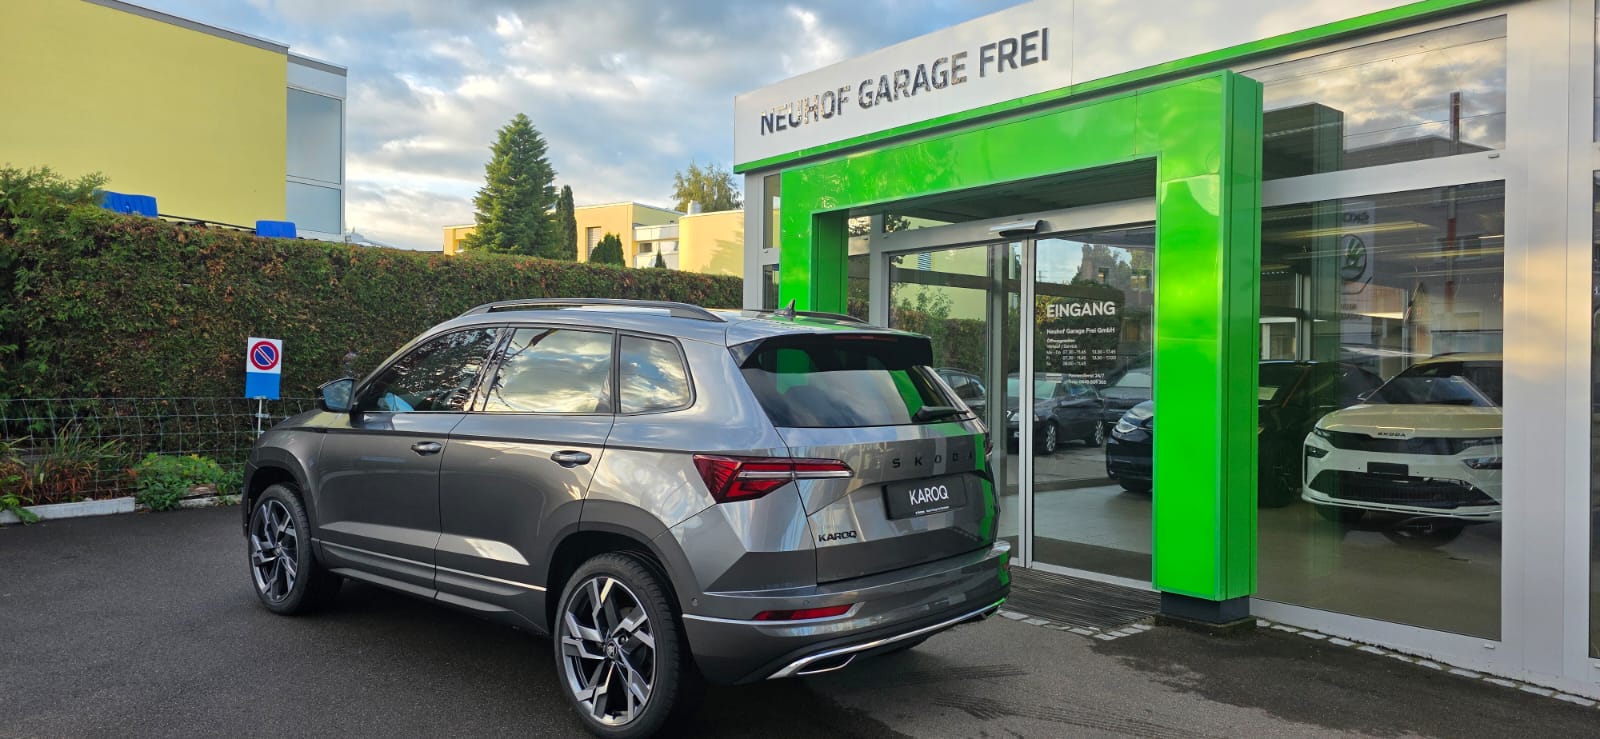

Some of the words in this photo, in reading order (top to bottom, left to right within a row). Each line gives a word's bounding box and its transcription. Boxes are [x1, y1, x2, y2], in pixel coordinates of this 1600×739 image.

[760, 85, 851, 136] NEUHOF
[858, 51, 968, 109] GARAGE
[979, 28, 1049, 77] FREI
[1046, 301, 1116, 318] EINGANG
[1066, 327, 1085, 336] Garage
[1086, 327, 1097, 335] Frei
[1097, 326, 1116, 335] GmbH
[908, 485, 950, 505] KAROQ
[818, 530, 858, 543] KAROQ
